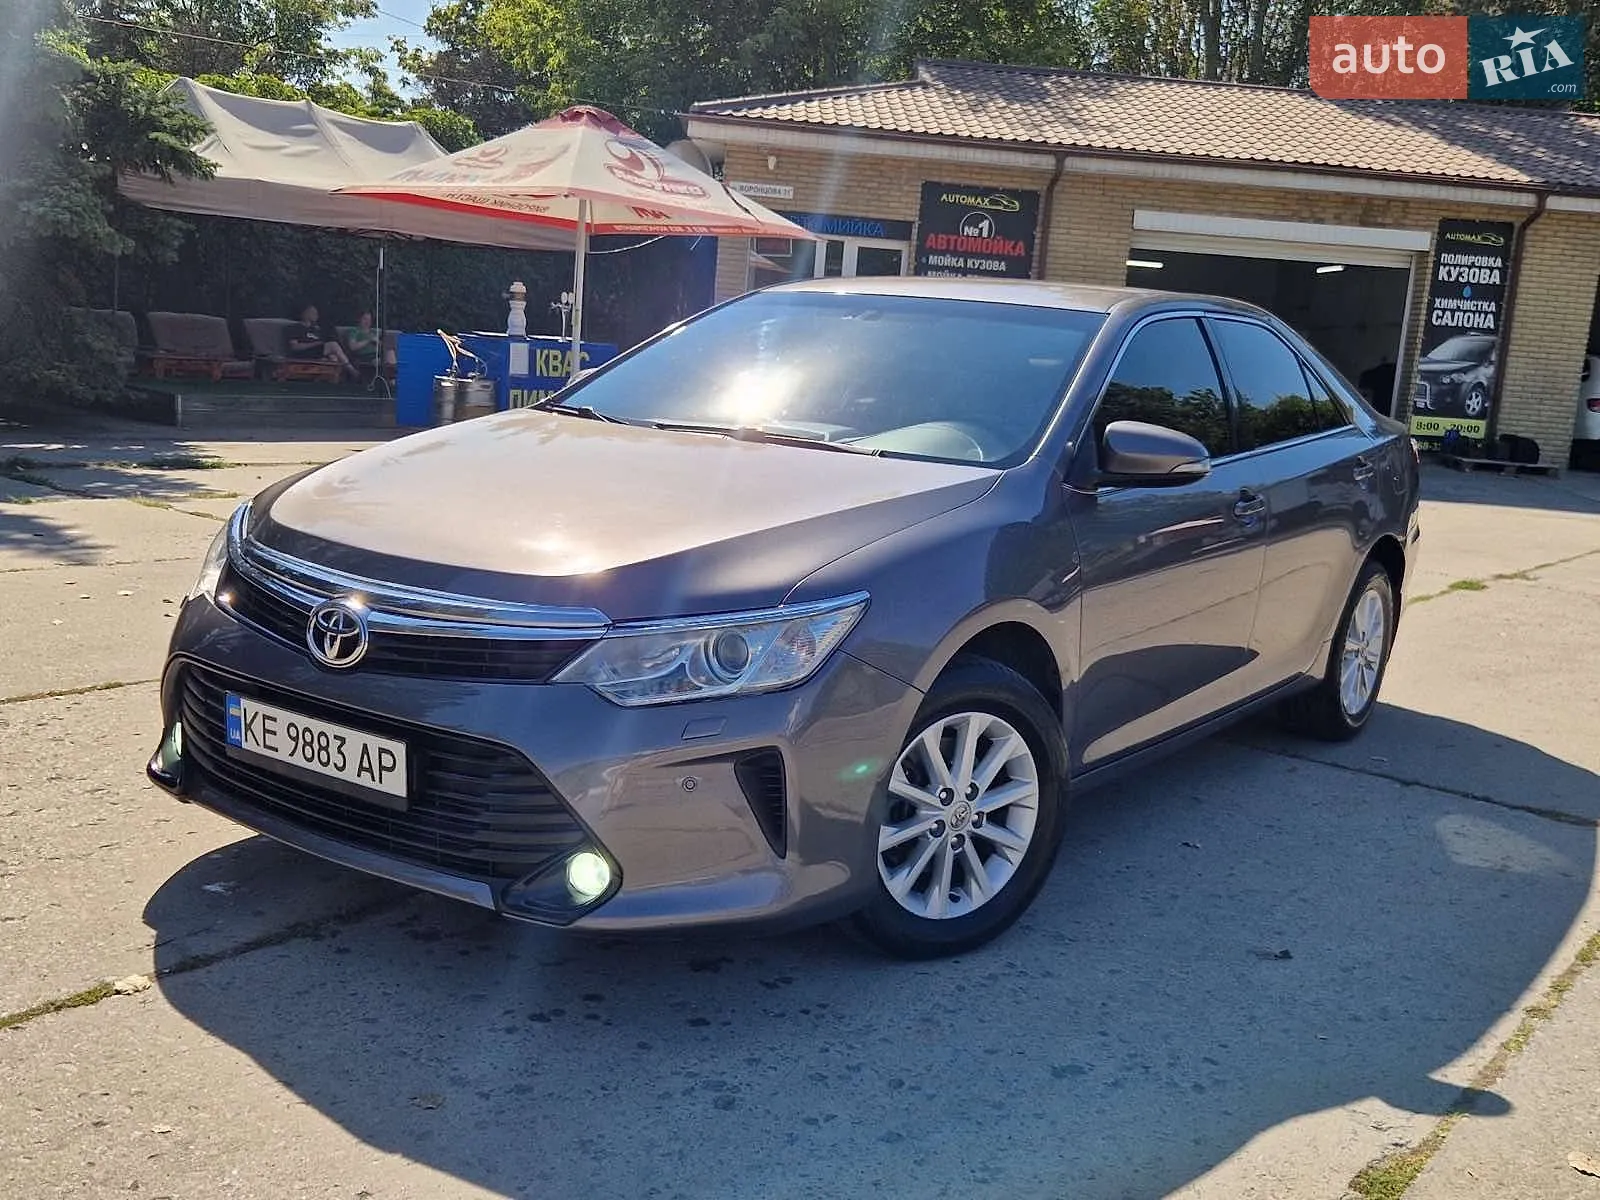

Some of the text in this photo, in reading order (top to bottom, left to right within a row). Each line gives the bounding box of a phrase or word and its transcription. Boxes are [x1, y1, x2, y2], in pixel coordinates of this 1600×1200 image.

[739, 184, 782, 196] ВОРОНЦОВА
[940, 193, 990, 207] AUTOMAX
[925, 234, 1026, 256] АВТОМОЙКА
[928, 254, 1007, 271] МОЙКА КУЗОВА
[1440, 253, 1503, 268] ПОЛИРОВКА
[1438, 264, 1501, 285] КУЗОВА
[1433, 297, 1497, 313] ХИМЧИСТКА
[1431, 309, 1496, 330] САЛОНА
[1415, 421, 1440, 431] 8:00
[230, 728, 242, 740] UA
[243, 707, 398, 785] KE 9883 AP
